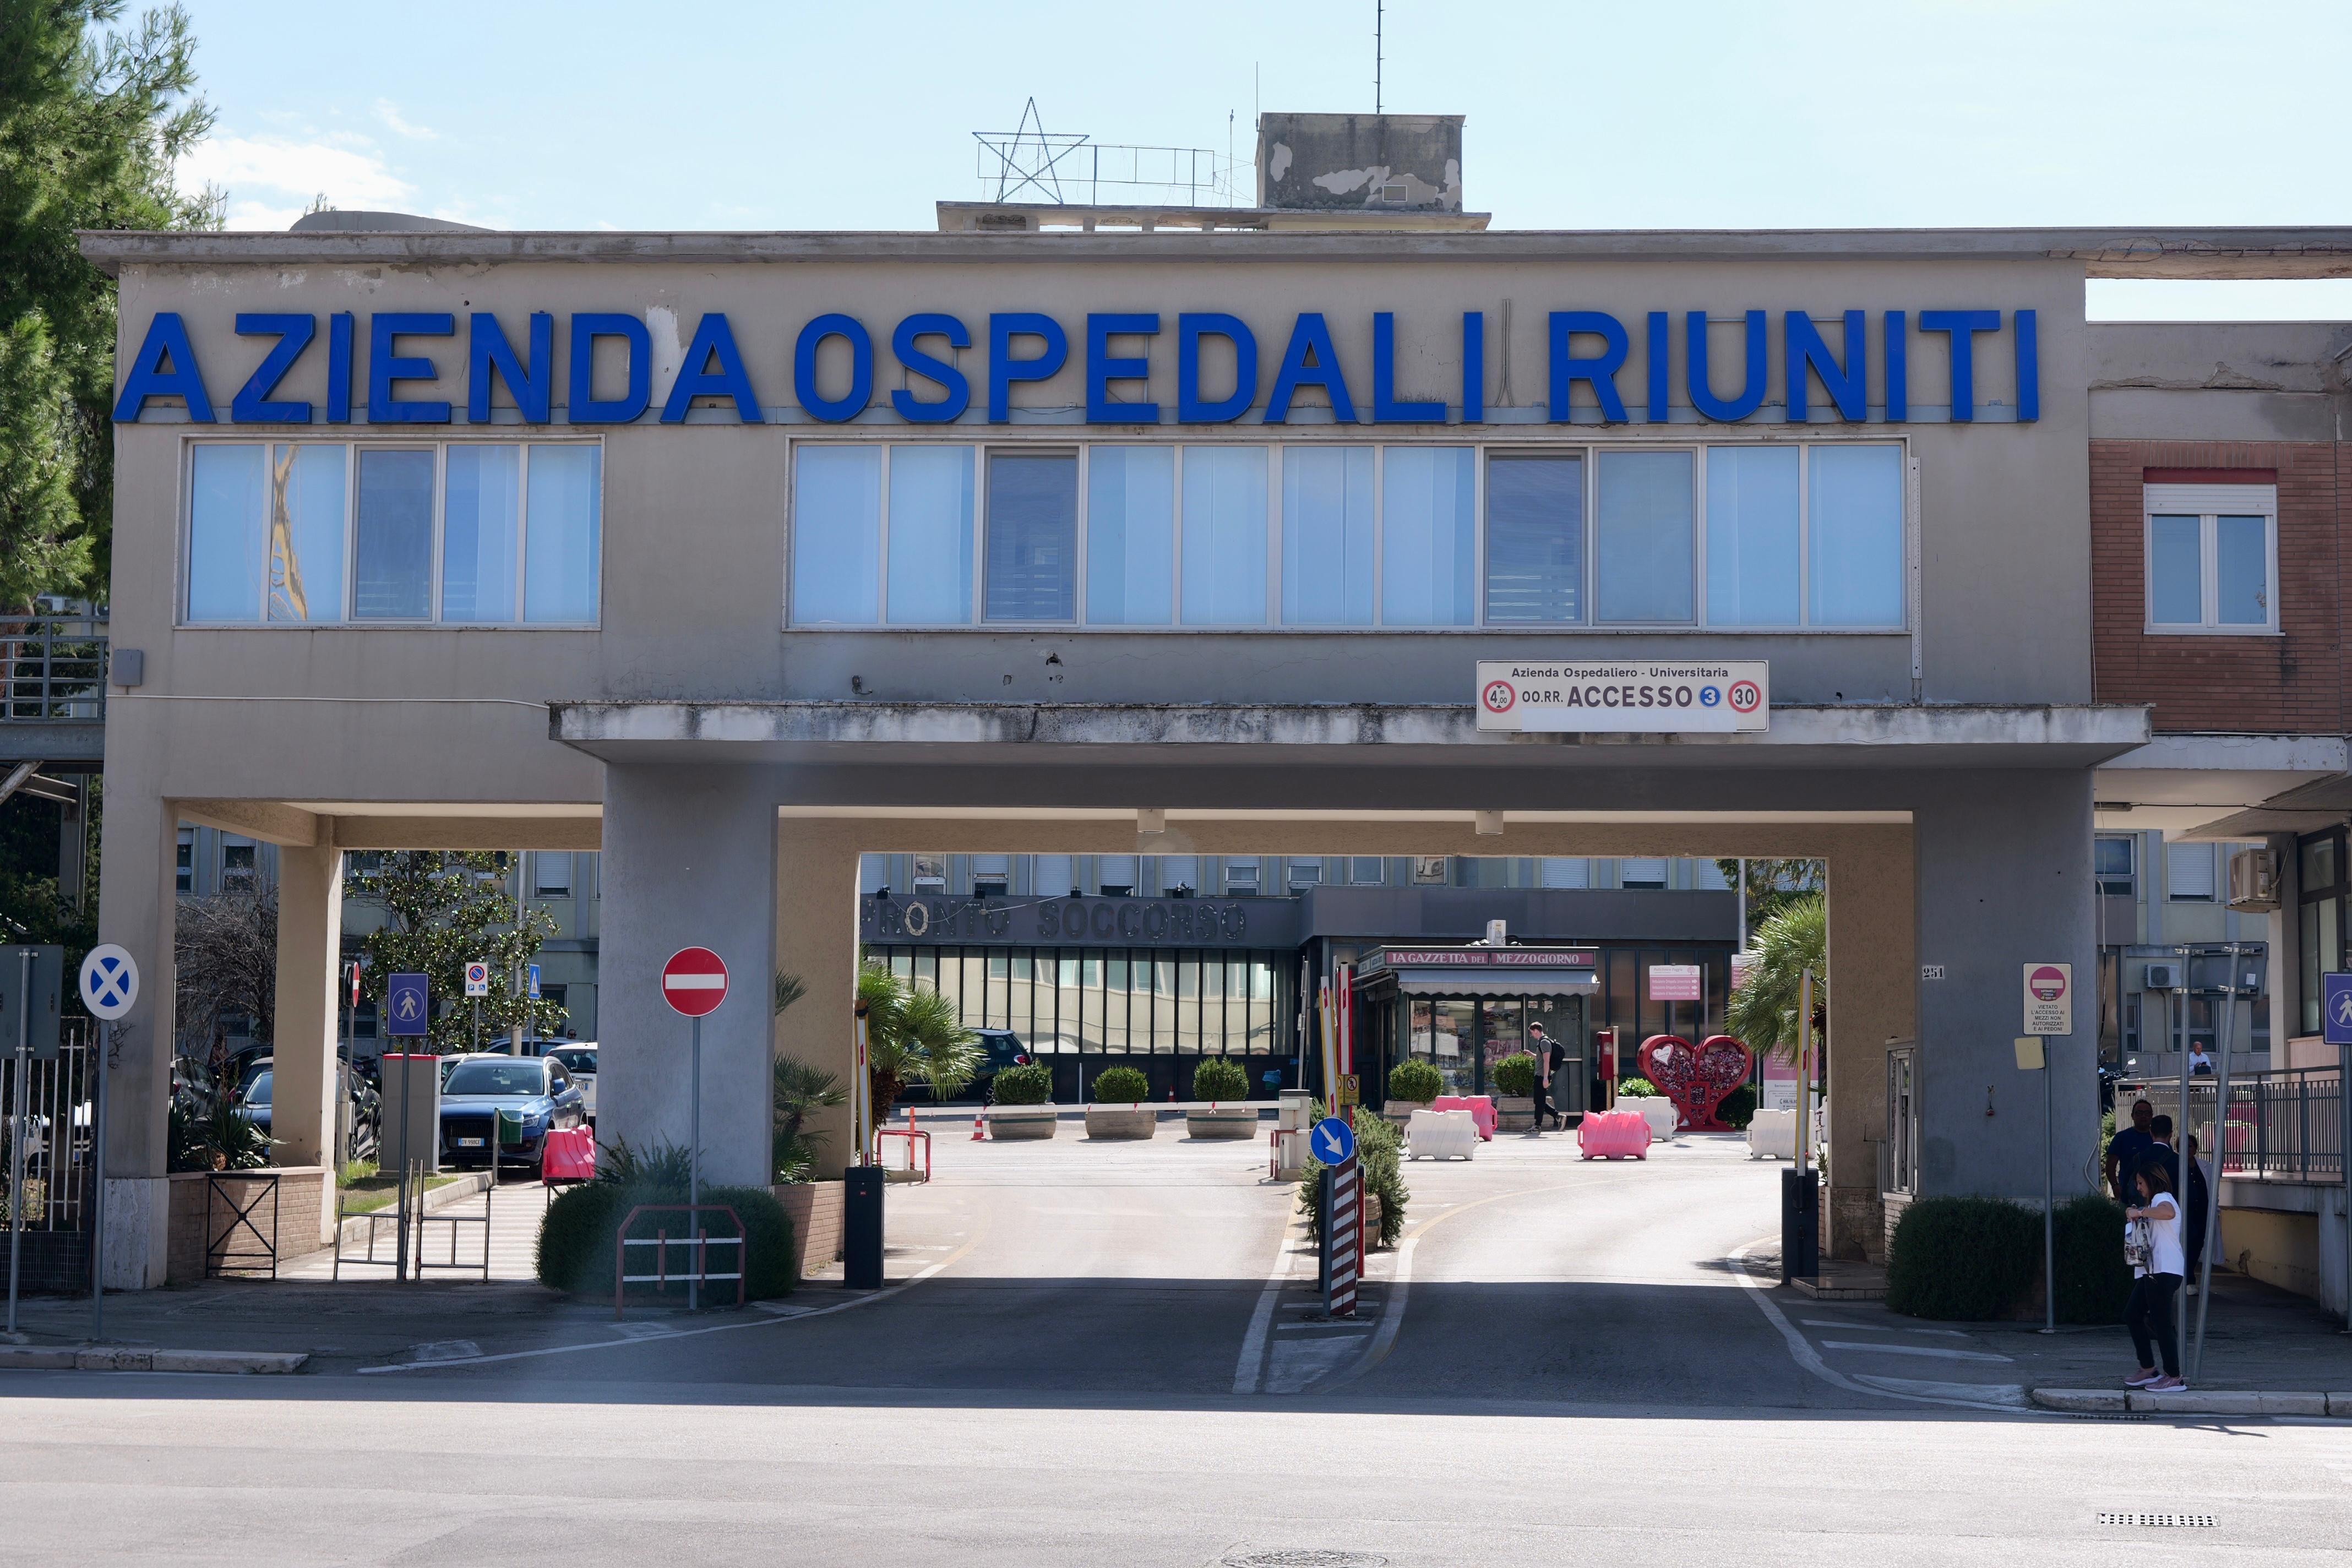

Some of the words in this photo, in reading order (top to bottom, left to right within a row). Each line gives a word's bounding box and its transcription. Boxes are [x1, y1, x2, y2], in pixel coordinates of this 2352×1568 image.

[111, 312, 765, 424] AZIENDA
[793, 312, 1483, 424] OSPEDALI
[1548, 309, 2039, 424] RIUNITI
[1512, 667, 1559, 678] Azienda
[1564, 667, 1637, 679] Ospedaliero
[1649, 667, 1729, 678] Universitaria
[1567, 685, 1693, 708] ACCESSO
[1704, 689, 1716, 704] 3
[1735, 688, 1754, 705] 30
[1037, 900, 1246, 940] SOCCORSO
[1392, 953, 1407, 963] LA
[1407, 953, 1468, 963] GAZZETTA
[1496, 953, 1580, 964] MEZZOGIORNO
[1923, 967, 1943, 978] 251
